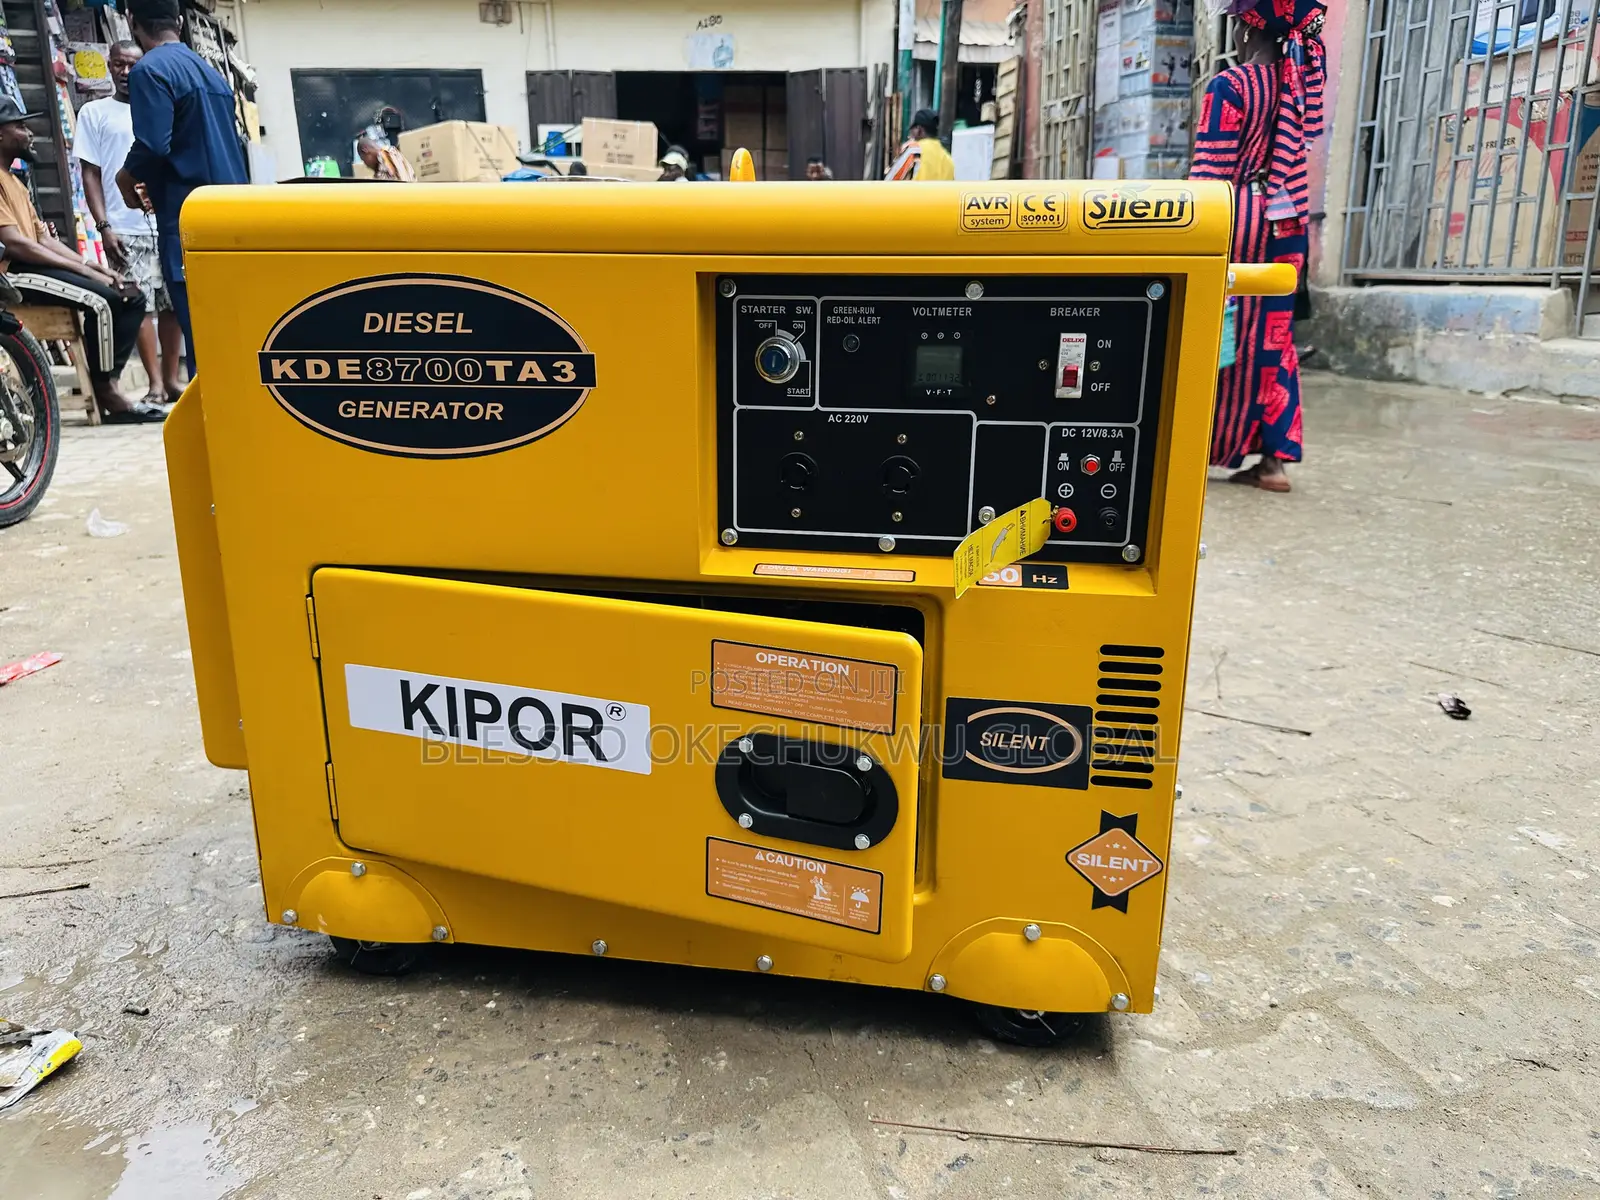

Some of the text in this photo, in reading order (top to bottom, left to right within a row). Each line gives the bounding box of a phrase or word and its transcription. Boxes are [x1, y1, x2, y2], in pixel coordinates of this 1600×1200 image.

[966, 196, 1009, 210] AVR
[1088, 193, 1189, 220] Silent
[970, 216, 1005, 227] system
[1020, 214, 1060, 222] ISO9001
[740, 305, 814, 315] STARTER SW.
[833, 306, 875, 315] GREEN-RUN
[912, 306, 972, 317] VOLTMETER
[1050, 307, 1100, 317] BREAKER
[363, 312, 474, 334] DIESEL
[858, 316, 881, 325] ALERT
[1097, 339, 1112, 349] ON
[270, 357, 577, 383] KDE8700TA3
[786, 387, 809, 395] START
[1091, 382, 1111, 392] OFF
[338, 400, 505, 421] GENERATOR
[828, 414, 869, 424] AC 220V
[1061, 428, 1124, 438] DC 12V/8.3A
[1057, 462, 1070, 471] ON
[1109, 462, 1126, 472] OFF
[1032, 574, 1058, 584] Hz
[756, 652, 849, 676] OPERATION
[979, 731, 1050, 751] SILENT
[766, 852, 827, 874] CAUTION
[1076, 853, 1153, 873] SILENT
